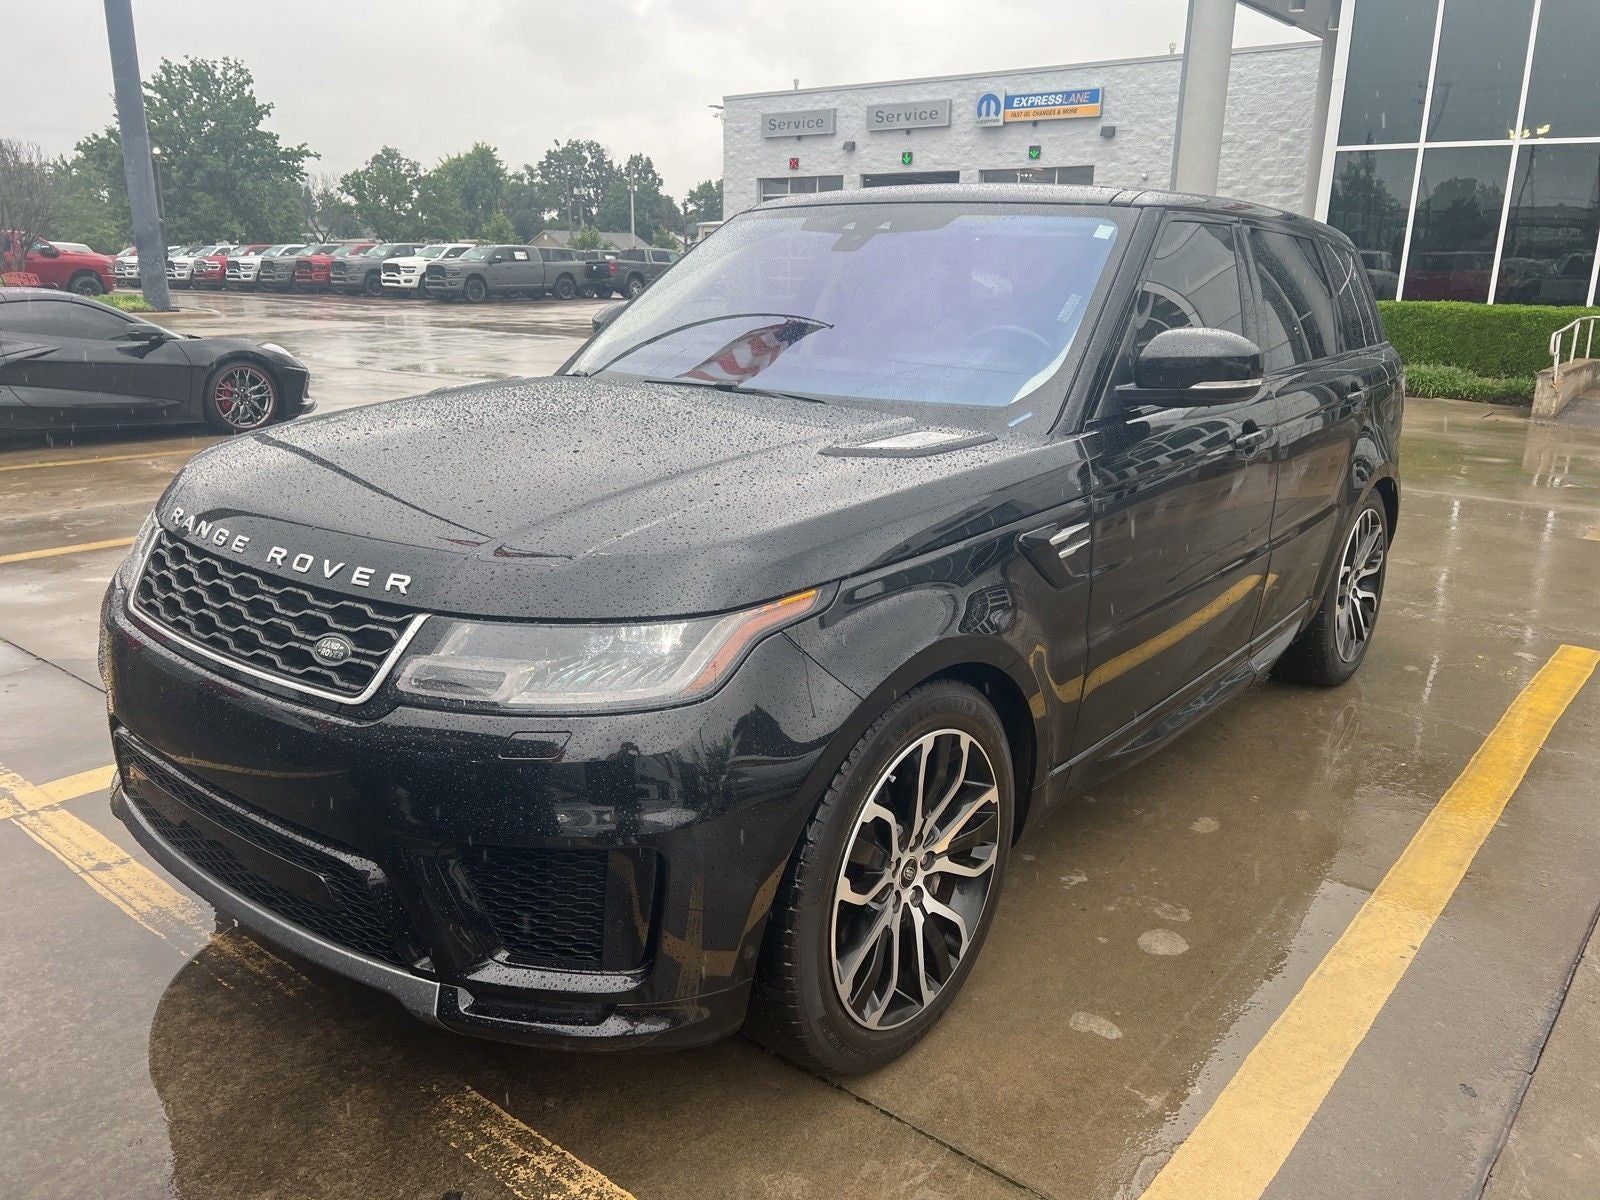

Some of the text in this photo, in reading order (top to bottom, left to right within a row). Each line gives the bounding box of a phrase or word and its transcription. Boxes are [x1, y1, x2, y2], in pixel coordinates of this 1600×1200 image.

[1013, 92, 1090, 108] EXPRESSLANE
[875, 108, 939, 124] Service
[1032, 108, 1056, 117] CHANGES
[1062, 107, 1078, 115] MORE
[768, 117, 824, 131] Service
[171, 507, 412, 594] RANGE ROVER
